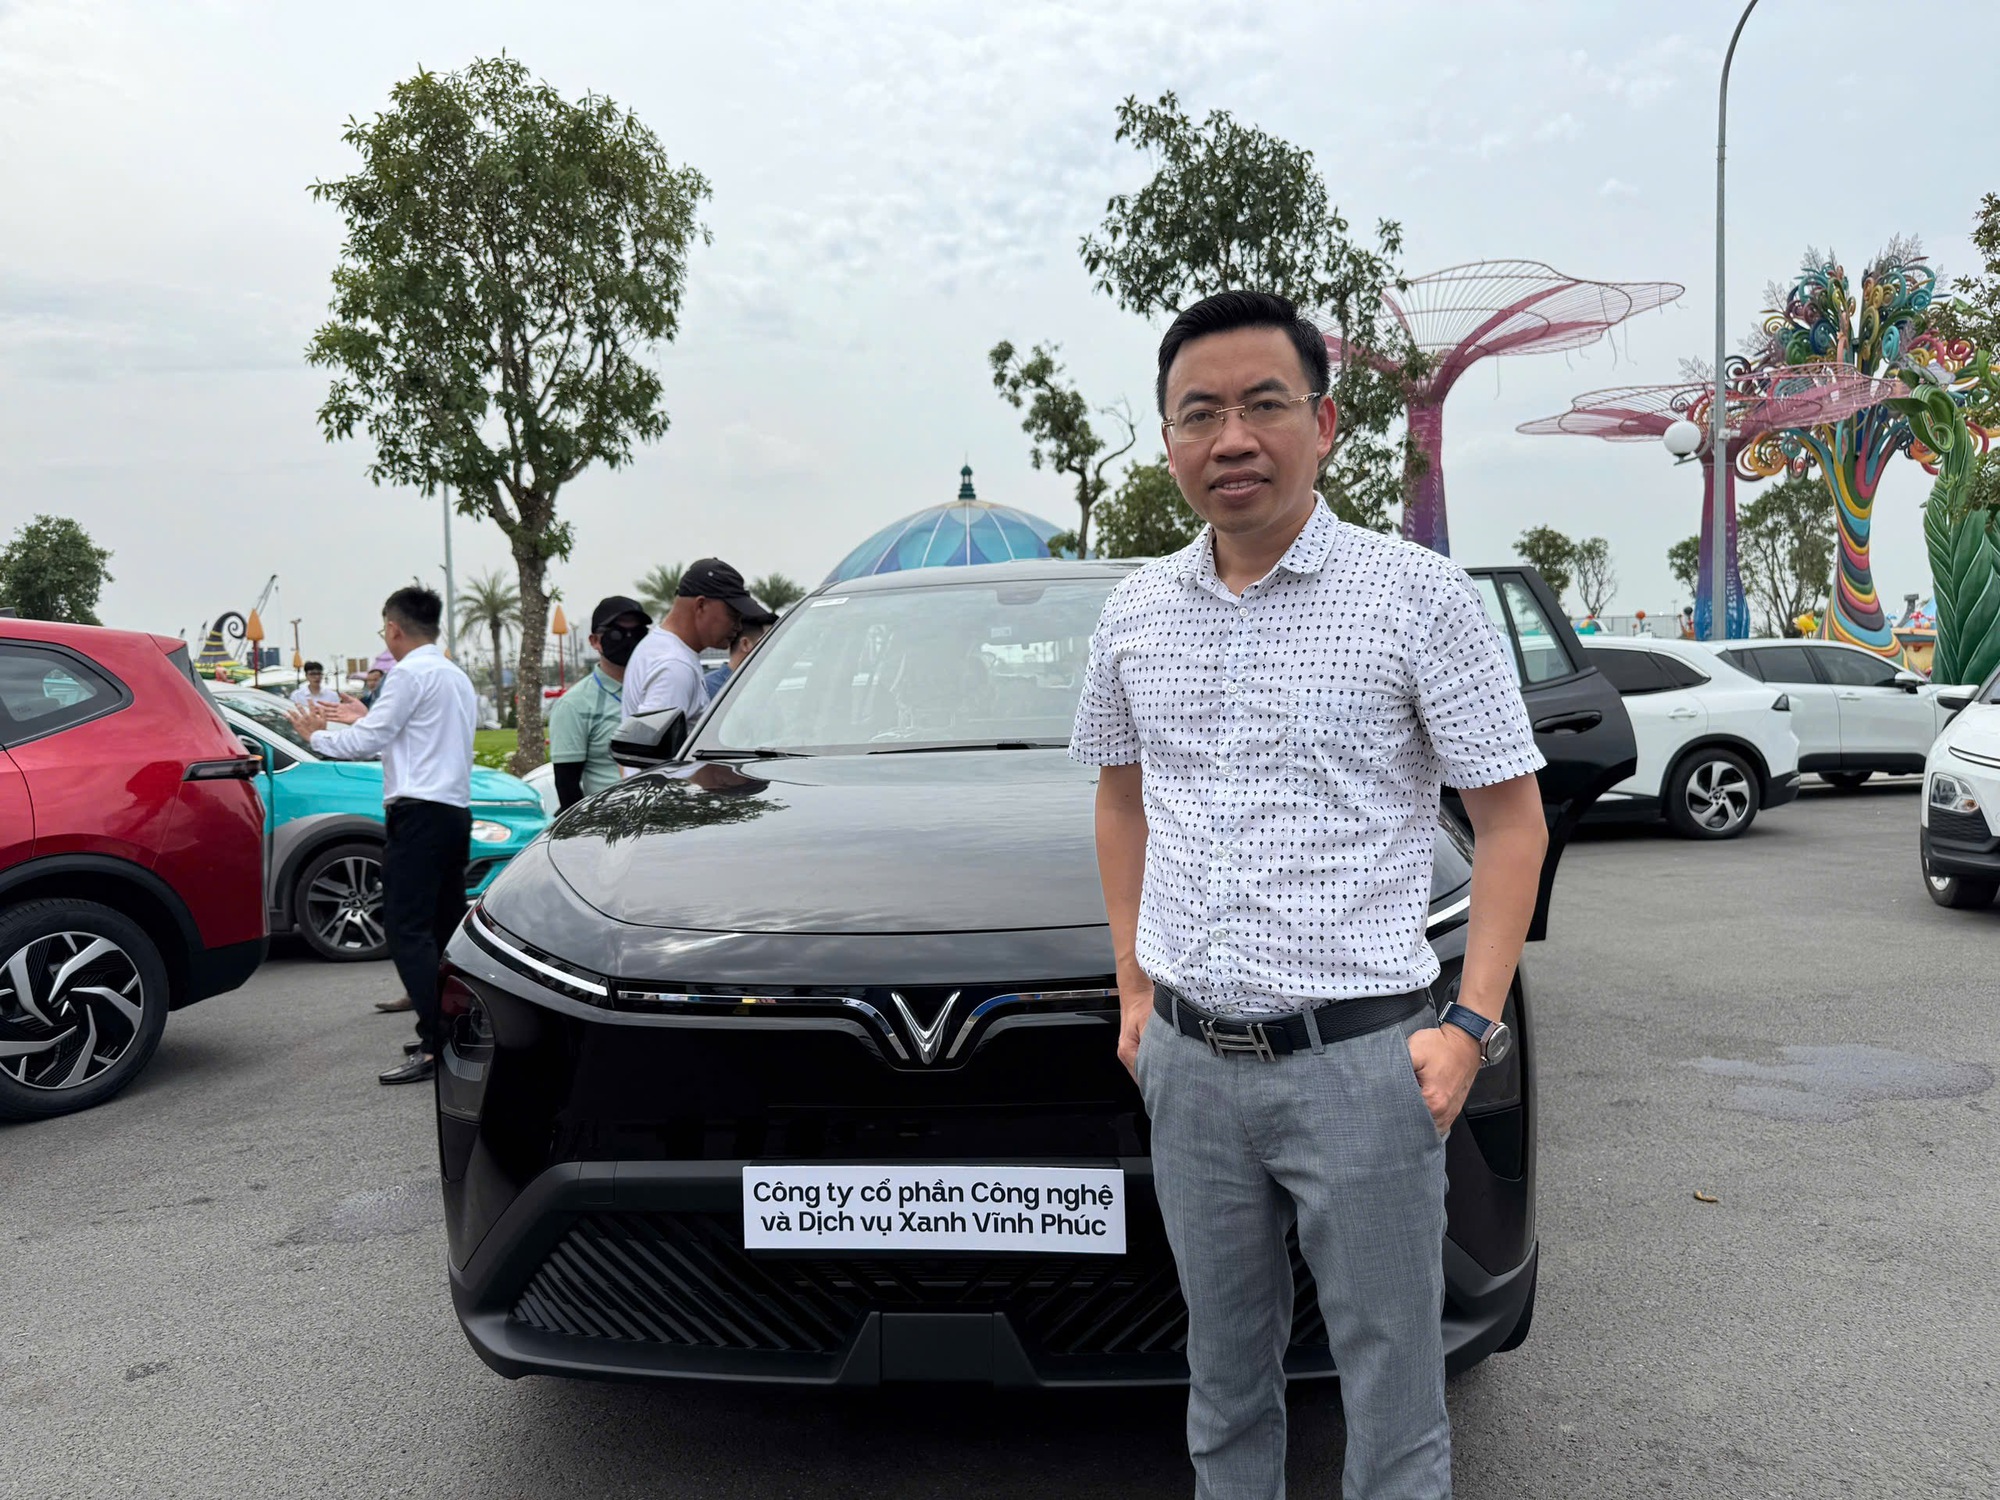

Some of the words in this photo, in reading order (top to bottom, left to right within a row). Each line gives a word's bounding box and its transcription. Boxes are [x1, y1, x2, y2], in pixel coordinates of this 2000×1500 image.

[753, 1181, 821, 1209] Công
[826, 1182, 854, 1209] ty
[860, 1177, 892, 1203] cổ
[898, 1178, 964, 1209] phần
[970, 1181, 1040, 1211] Công
[1046, 1183, 1114, 1211] nghệ
[760, 1210, 793, 1232] và
[798, 1210, 855, 1236] Dịch
[859, 1215, 892, 1237] vụ
[898, 1211, 967, 1233] Xanh
[971, 1211, 1034, 1234] Vĩnh
[1040, 1213, 1107, 1237] Phúc
